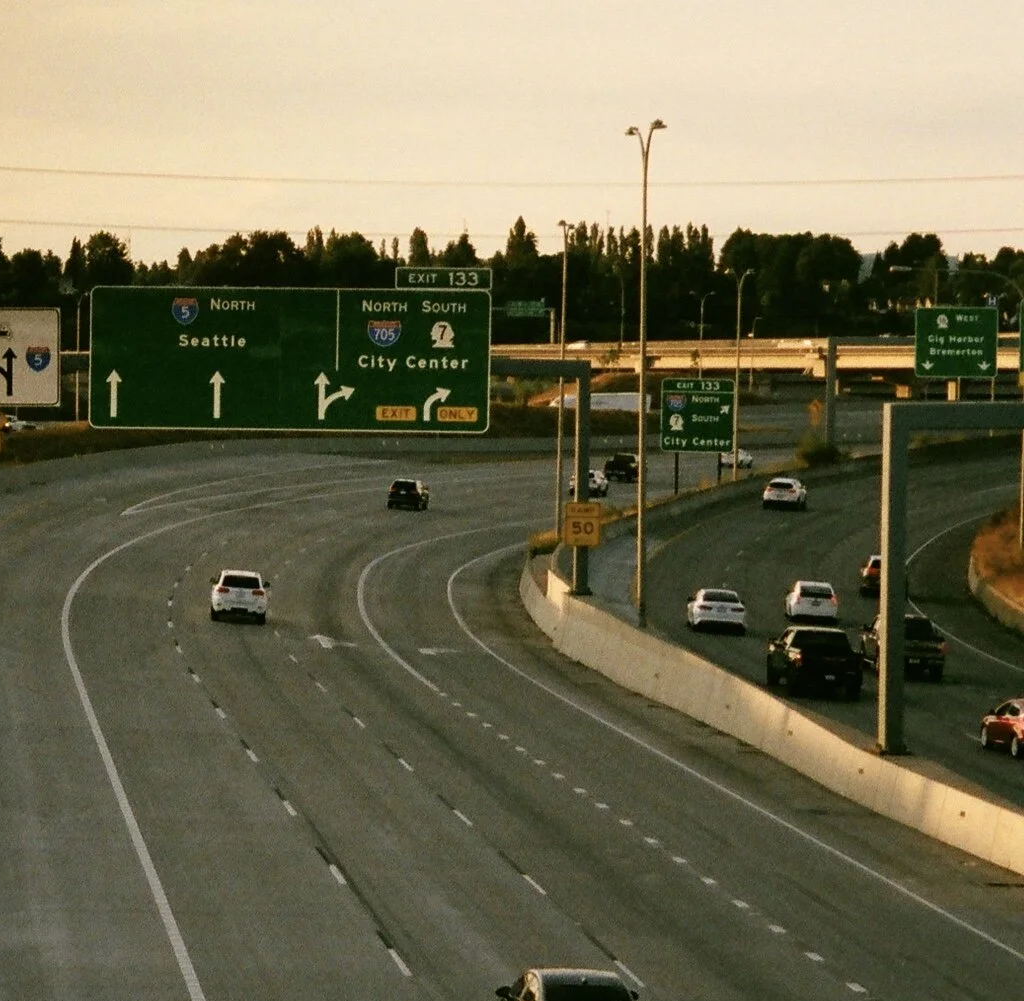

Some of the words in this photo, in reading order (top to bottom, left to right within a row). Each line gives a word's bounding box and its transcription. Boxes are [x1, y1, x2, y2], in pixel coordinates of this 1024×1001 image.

[408, 273, 437, 284] EXIT
[449, 272, 479, 286] 133
[210, 298, 256, 311] NORTH
[362, 300, 408, 312] NORTH
[422, 301, 467, 313] SOUTH
[181, 306, 190, 319] 5
[374, 328, 396, 341] 705
[438, 324, 447, 340] 7
[178, 334, 247, 348] Seattle
[929, 347, 983, 356] Bremerton
[33, 354, 43, 368] 5
[358, 355, 397, 372] City
[406, 356, 469, 369] Center
[701, 382, 720, 390] 133
[382, 408, 410, 419] EXIT
[439, 408, 475, 420] ONLY
[692, 414, 720, 422] SOUTH
[663, 436, 688, 448] City
[692, 437, 731, 446] Center
[572, 522, 594, 535] 50
